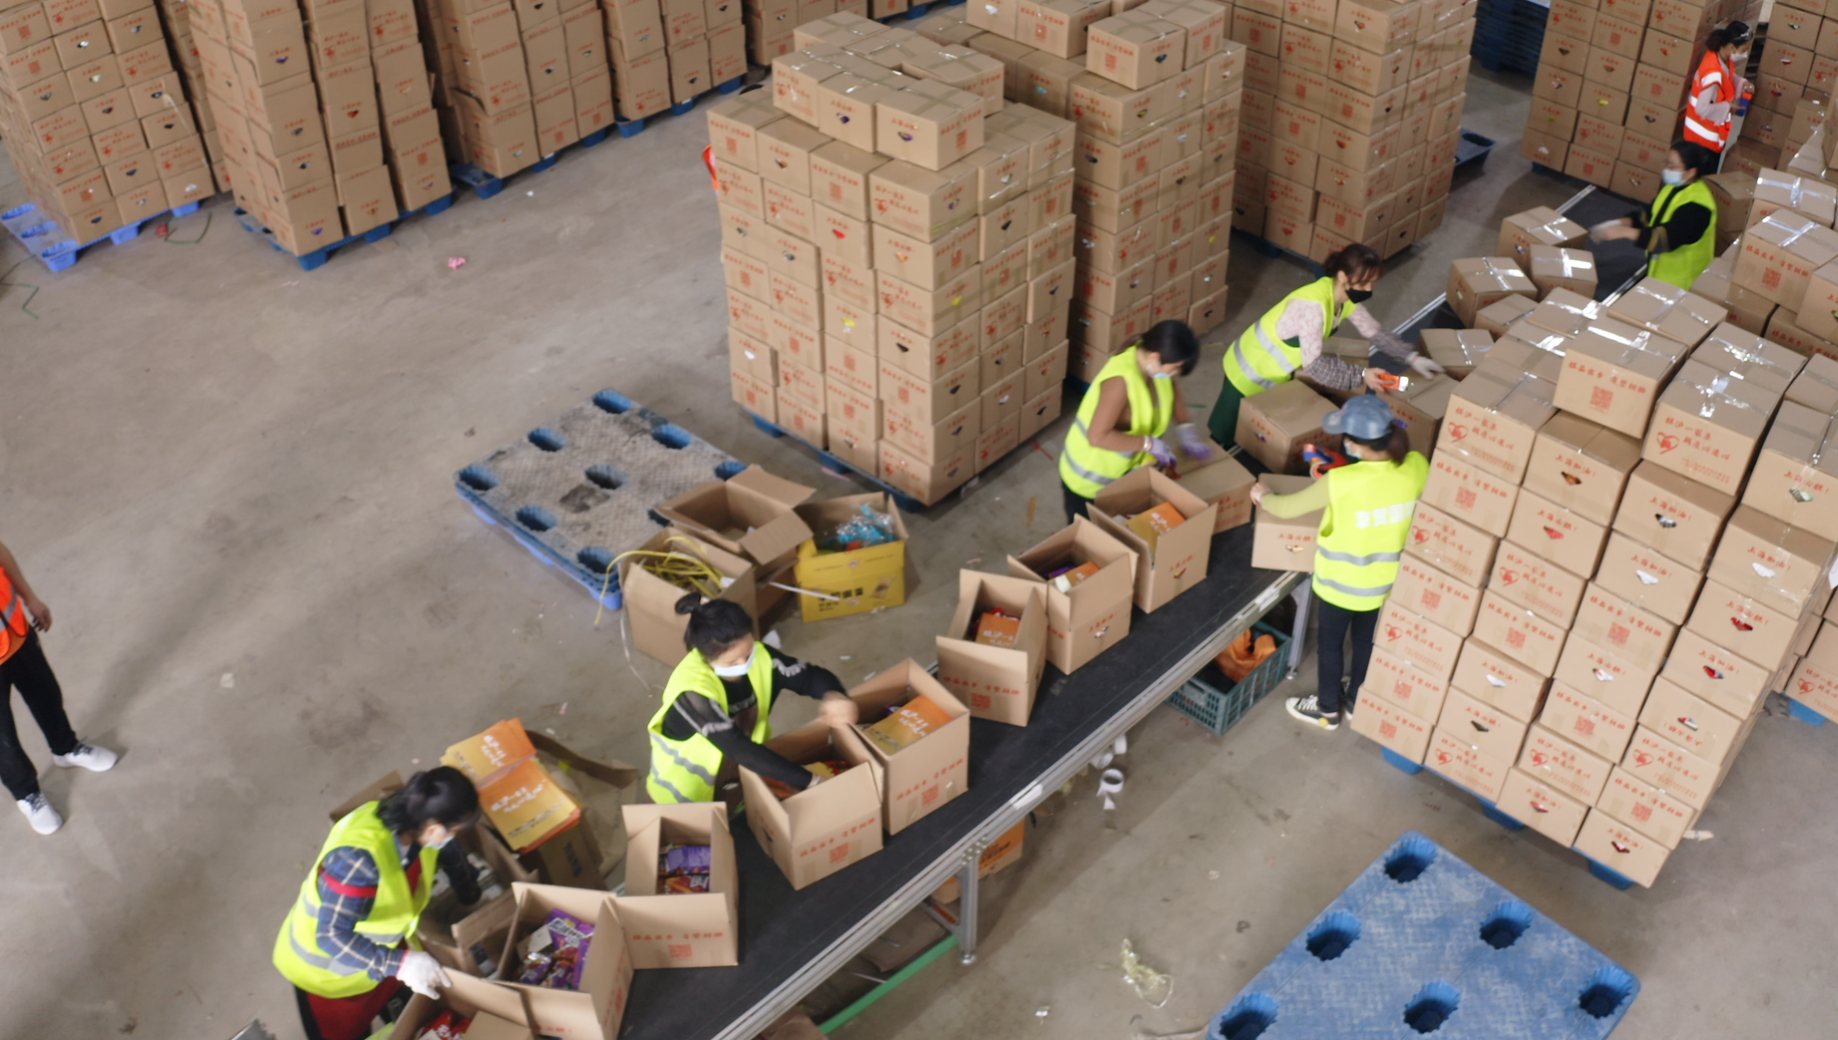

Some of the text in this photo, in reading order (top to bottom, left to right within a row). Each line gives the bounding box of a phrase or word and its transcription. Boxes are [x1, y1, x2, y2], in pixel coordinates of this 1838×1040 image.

[1568, 361, 1647, 394] 桂品出乡 守望相助
